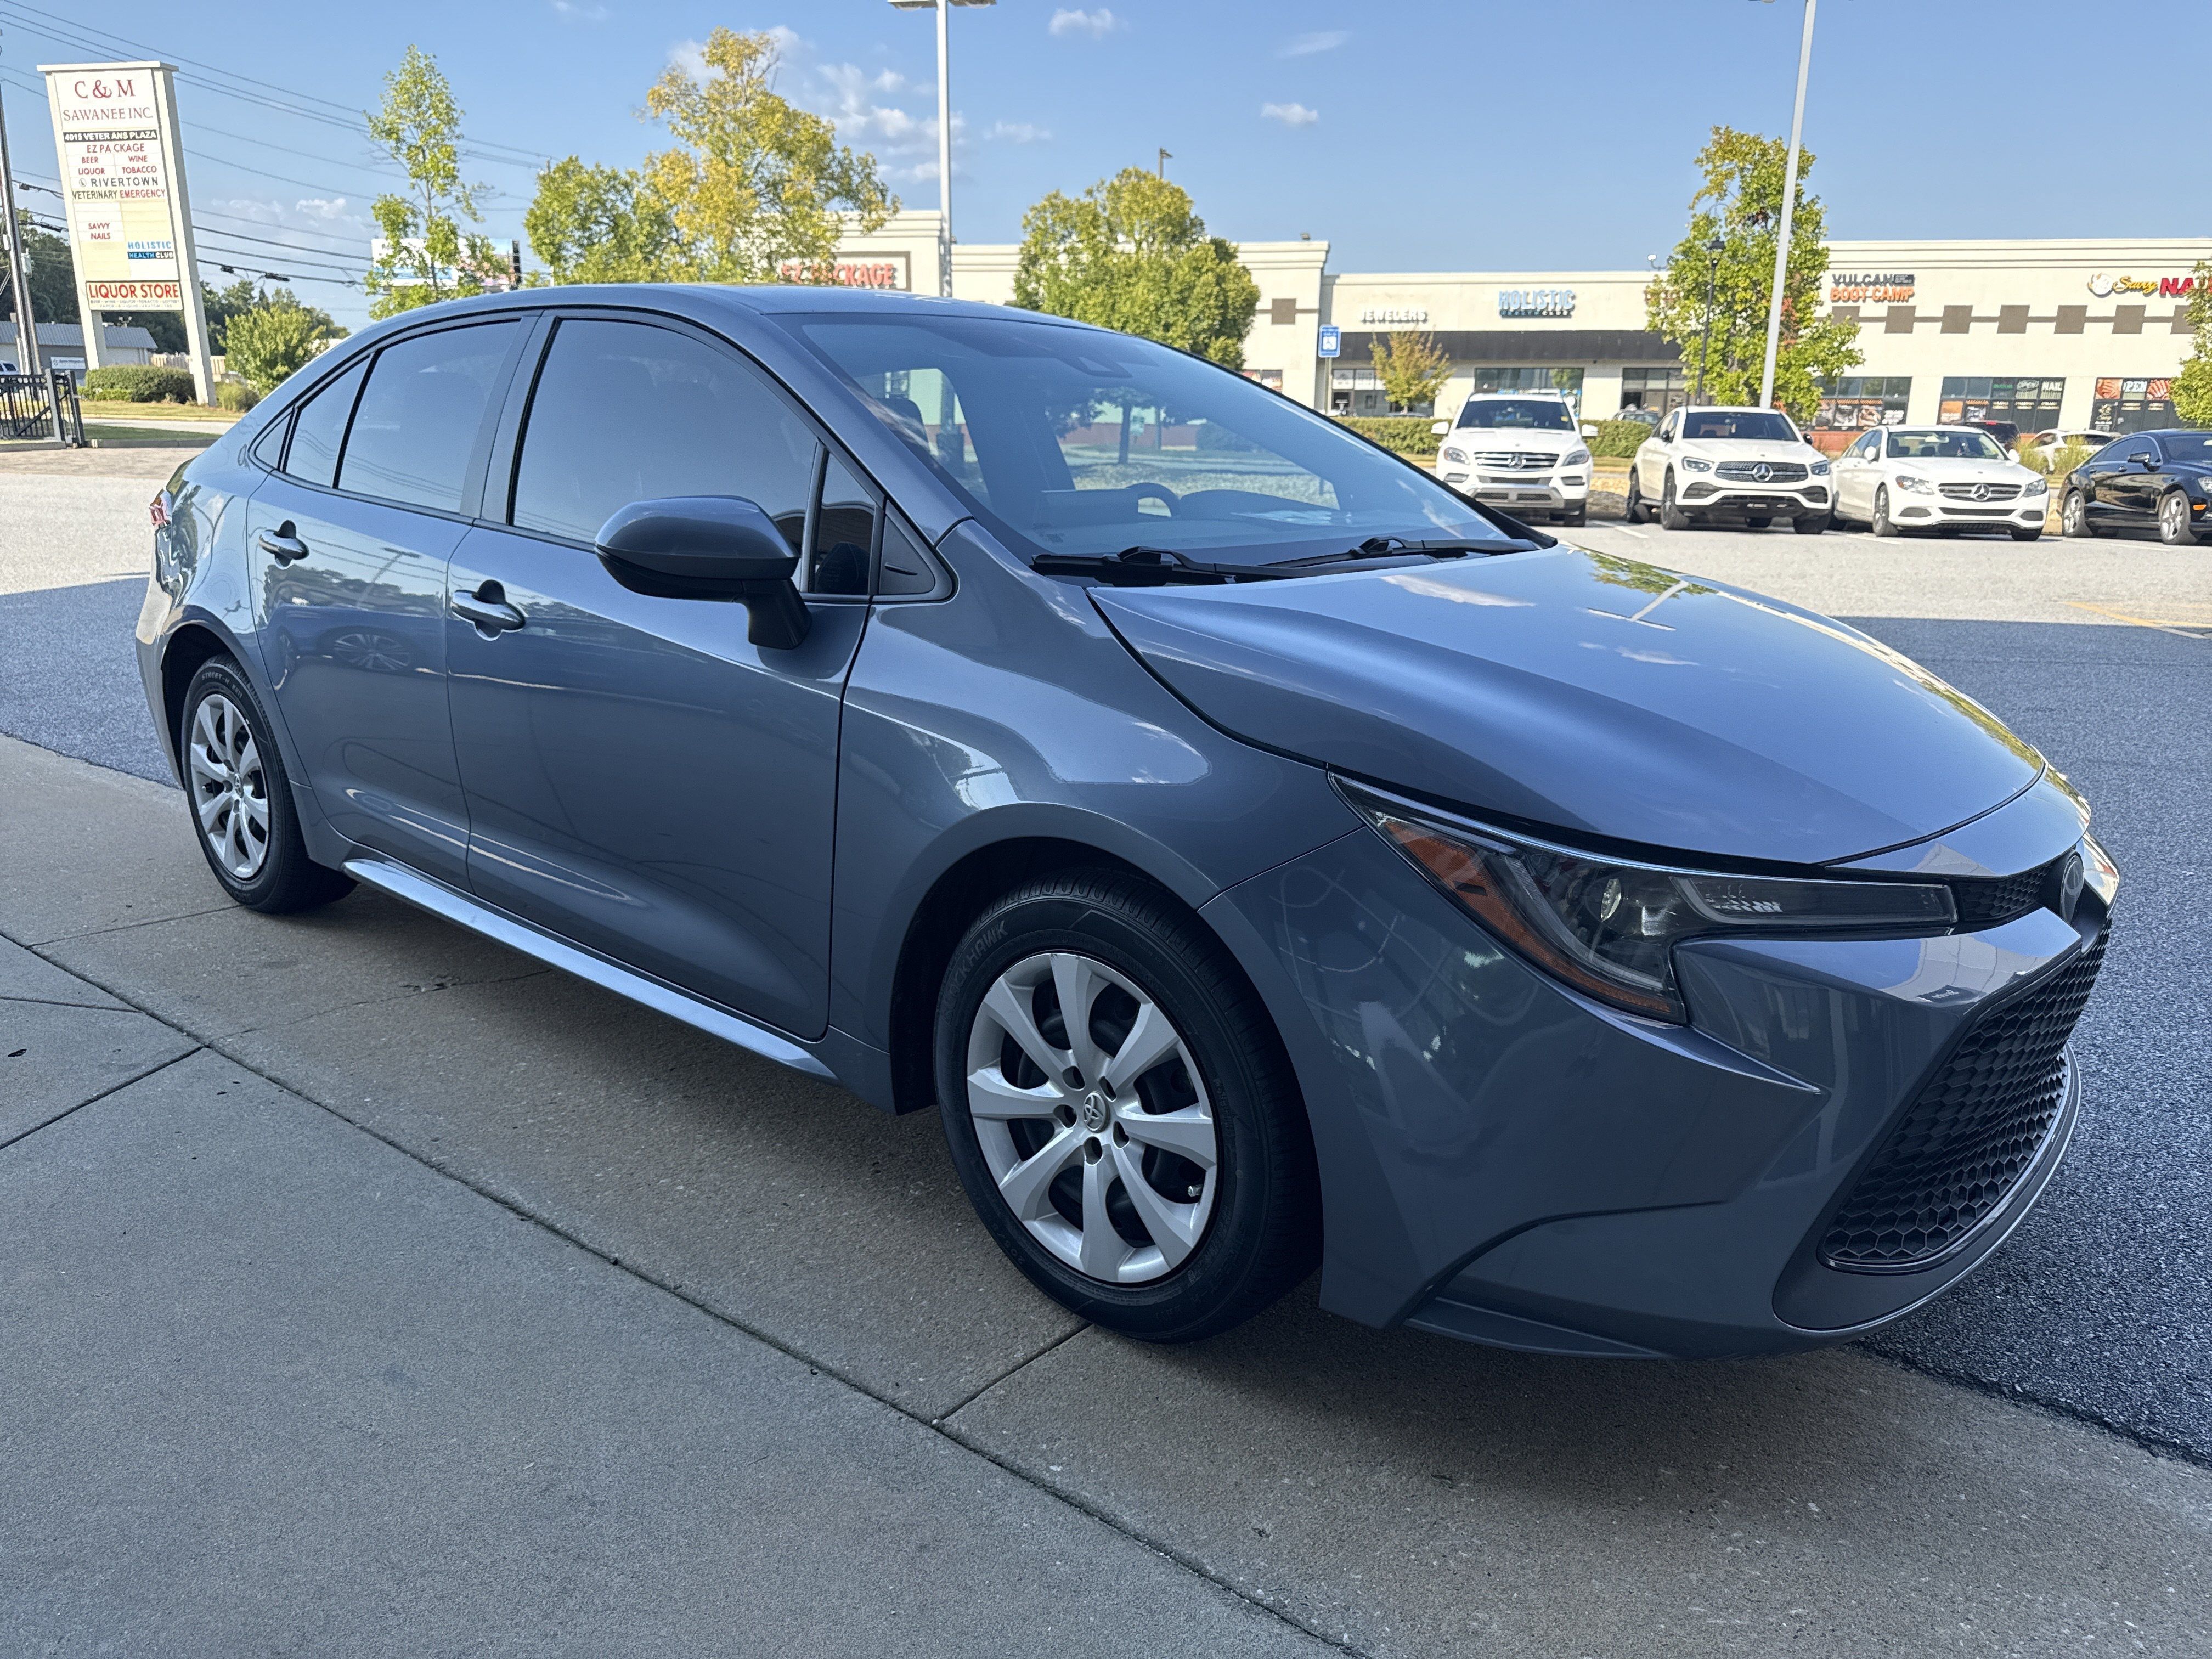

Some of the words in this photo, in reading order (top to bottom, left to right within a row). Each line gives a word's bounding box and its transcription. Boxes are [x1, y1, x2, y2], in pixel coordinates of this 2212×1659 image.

[75, 81, 88, 99] C
[92, 80, 112, 98] &
[115, 79, 136, 97] M
[63, 109, 126, 121] SAWANEE
[128, 107, 154, 119] INC.
[129, 131, 157, 139] PLAZA
[87, 144, 98, 153] EZ
[121, 166, 157, 174] TOBACCO
[91, 177, 159, 187] RIVERTOWN
[72, 189, 117, 199] VETERINARY
[119, 189, 165, 198] EMERGENCY
[127, 241, 172, 249] HOLISTIC
[1831, 274, 1894, 287] VULCAN
[2113, 275, 2159, 295] Savvy
[88, 284, 138, 298] LIQUOR
[140, 284, 179, 298] STORE
[1830, 286, 1869, 303] BOOT
[1872, 286, 1915, 303] CAMP
[1498, 290, 1576, 311] HOLISTIC
